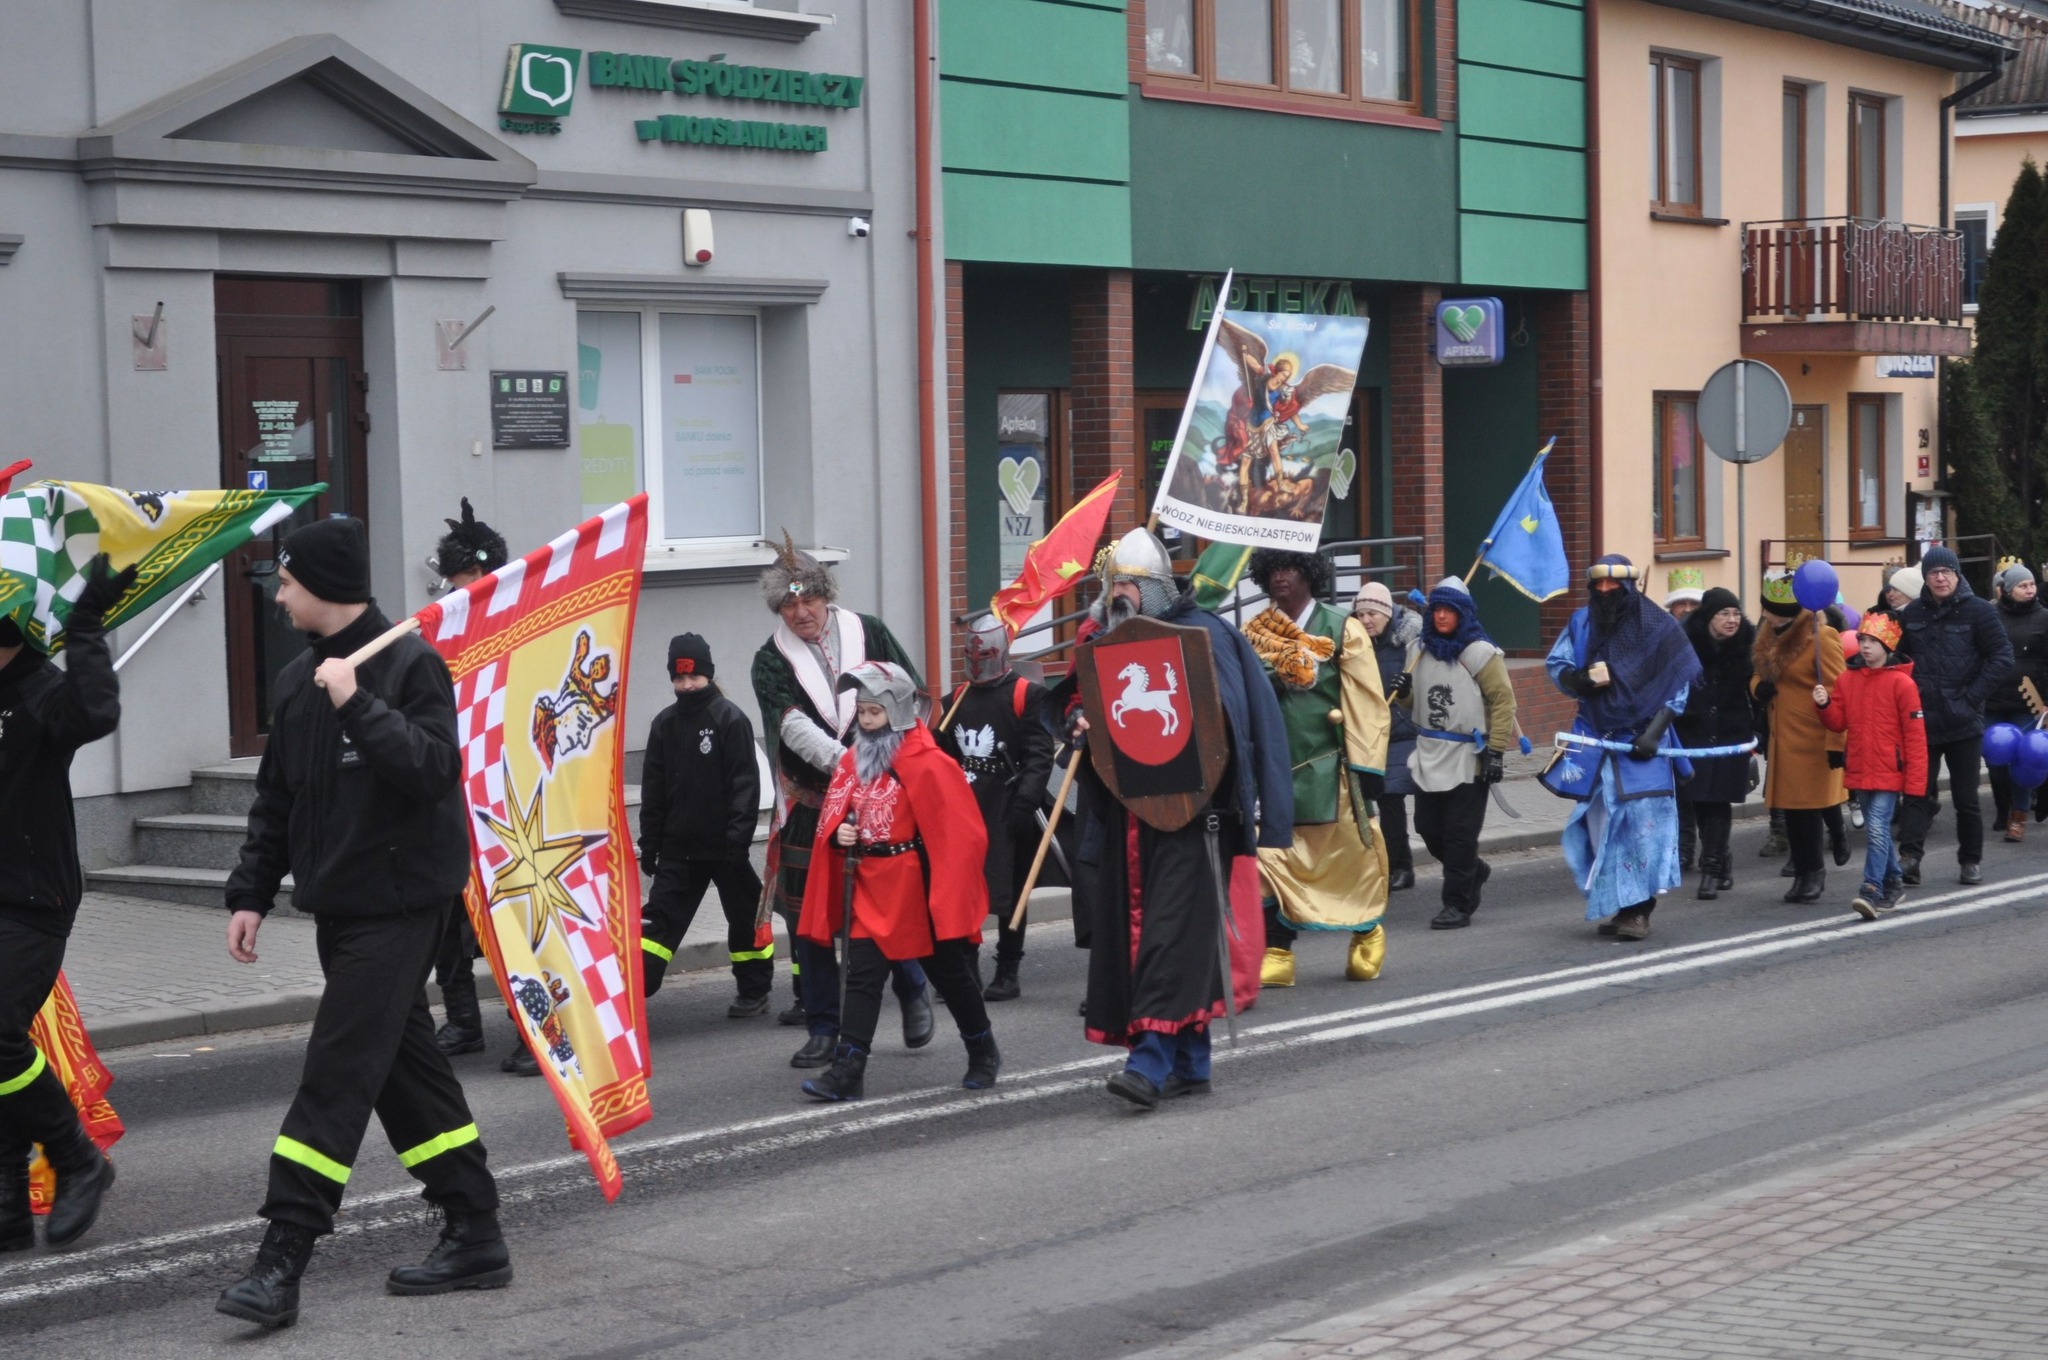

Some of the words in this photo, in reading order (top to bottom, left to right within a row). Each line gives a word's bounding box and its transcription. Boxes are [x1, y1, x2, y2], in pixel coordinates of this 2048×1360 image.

[588, 51, 673, 92] BANK
[672, 53, 864, 110] SPÓŁDZIELCZY
[1190, 276, 1357, 330] APTEKA
[1444, 345, 1485, 356] APTEKA
[1001, 416, 1037, 434] Apteka
[1918, 428, 1929, 449] 29
[1005, 516, 1032, 537] NFZ
[1161, 503, 1194, 524] WÓDZ
[1196, 517, 1260, 538] NIEBIESKICH
[1260, 527, 1314, 544] ZASTĘPÓW
